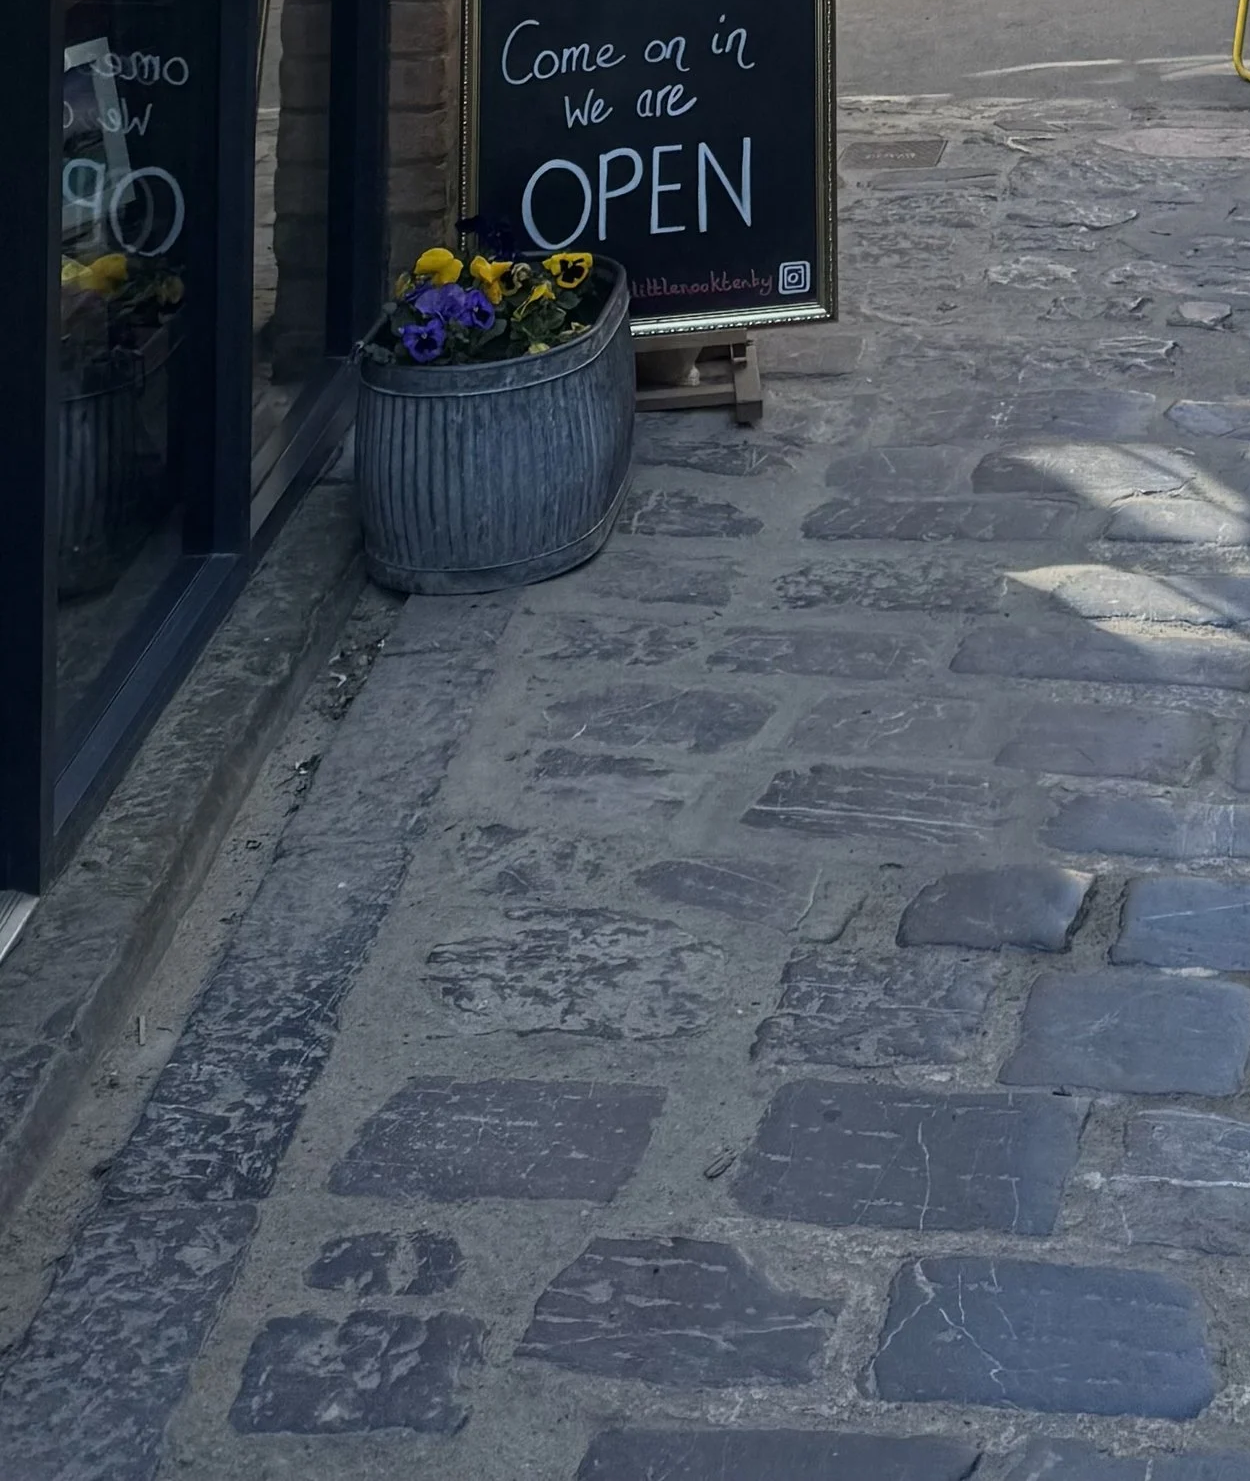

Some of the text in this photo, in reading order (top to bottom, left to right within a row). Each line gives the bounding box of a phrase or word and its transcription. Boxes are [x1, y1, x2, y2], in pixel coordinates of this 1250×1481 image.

[502, 14, 755, 85] Come on in
[564, 84, 697, 129] We are
[521, 137, 751, 251] OPEN
